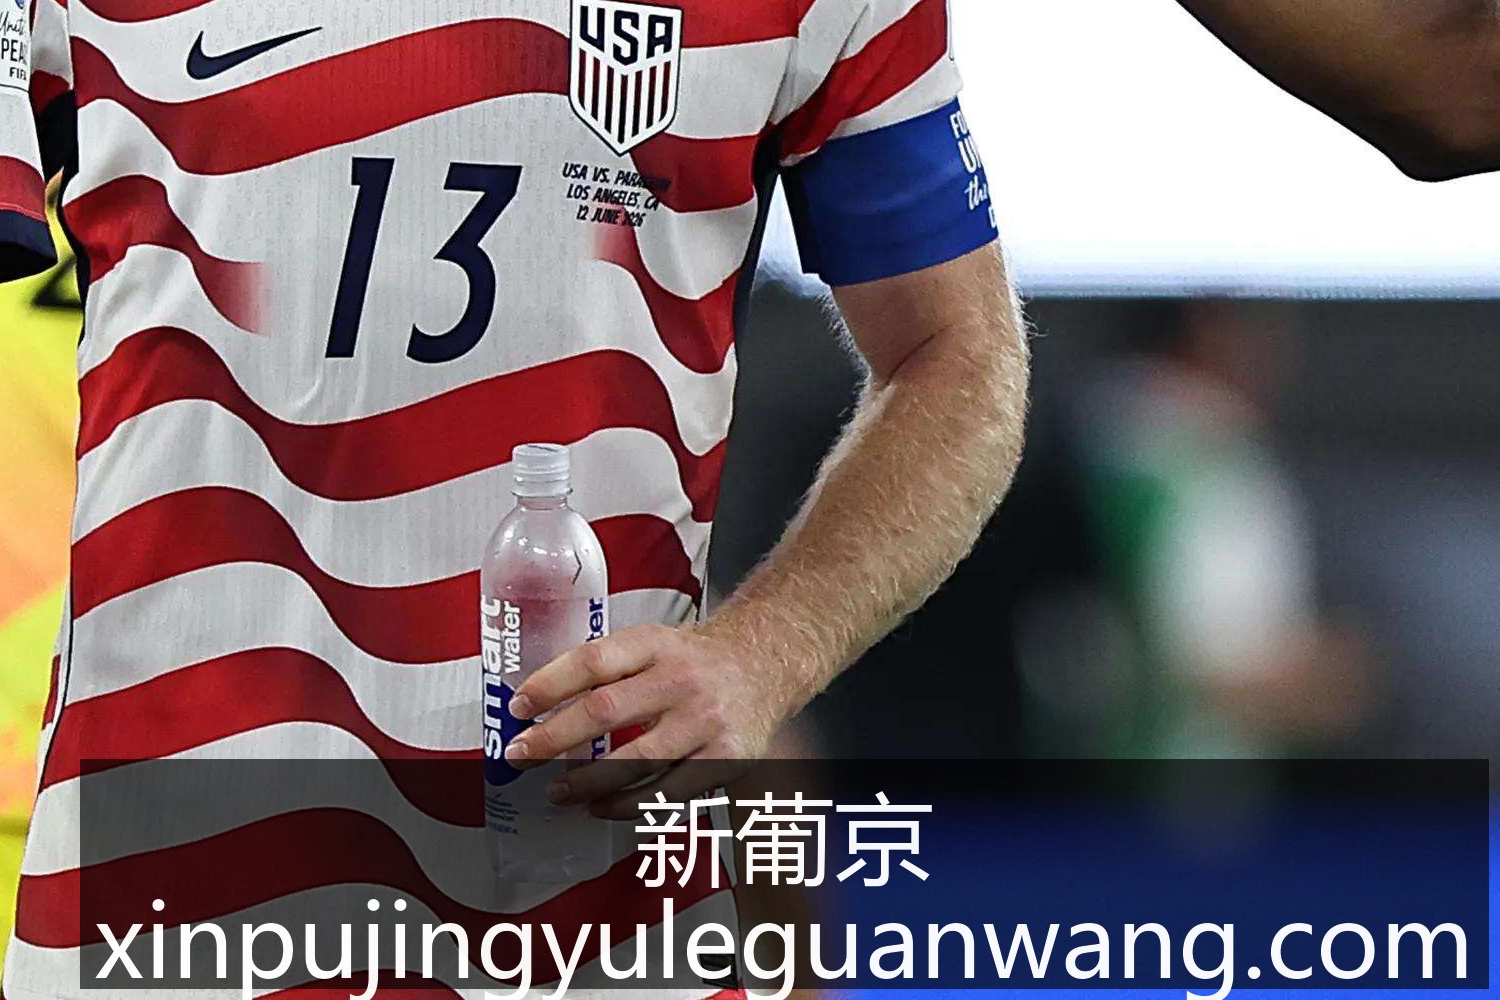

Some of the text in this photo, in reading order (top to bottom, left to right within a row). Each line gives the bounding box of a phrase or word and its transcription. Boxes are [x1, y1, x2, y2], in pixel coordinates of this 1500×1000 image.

[580, 6, 673, 66] USA
[562, 162, 588, 180] USA
[567, 183, 591, 201] LOS
[644, 195, 660, 211] CA
[577, 204, 589, 221] 12
[591, 208, 621, 224] JUNE
[325, 157, 523, 363] 13
[501, 600, 521, 674] water
[586, 597, 603, 642] ter
